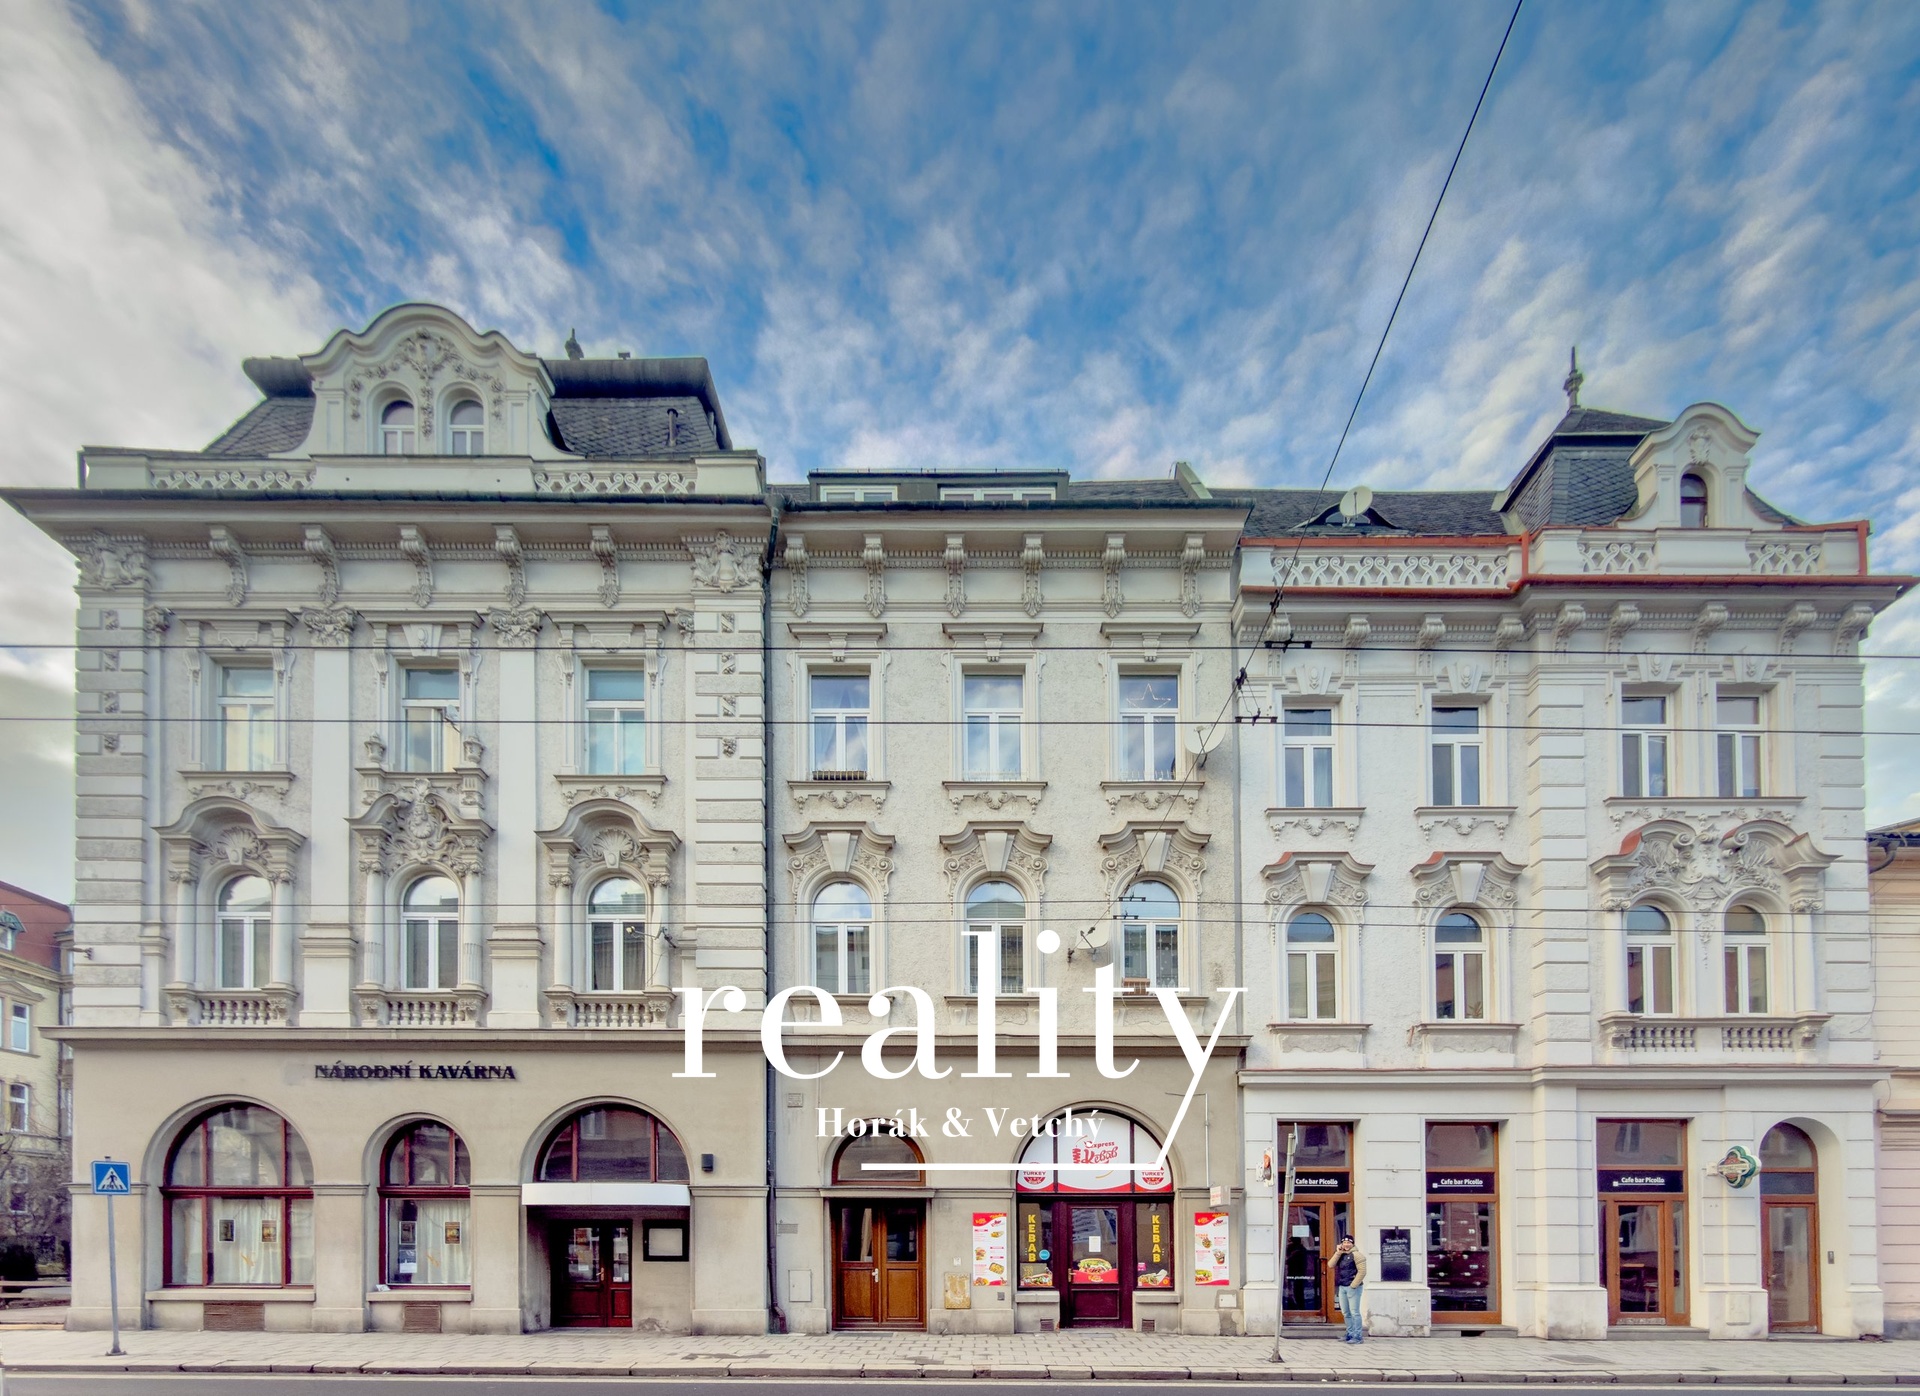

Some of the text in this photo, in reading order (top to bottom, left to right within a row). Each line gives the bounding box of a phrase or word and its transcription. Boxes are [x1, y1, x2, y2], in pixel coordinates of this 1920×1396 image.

[314, 1060, 516, 1080] NÁRODNÍ KAVÁRNA
[1318, 1178, 1338, 1186] Picollo
[1028, 1214, 1036, 1262] KEBAB
[1152, 1215, 1161, 1262] KEBAB
